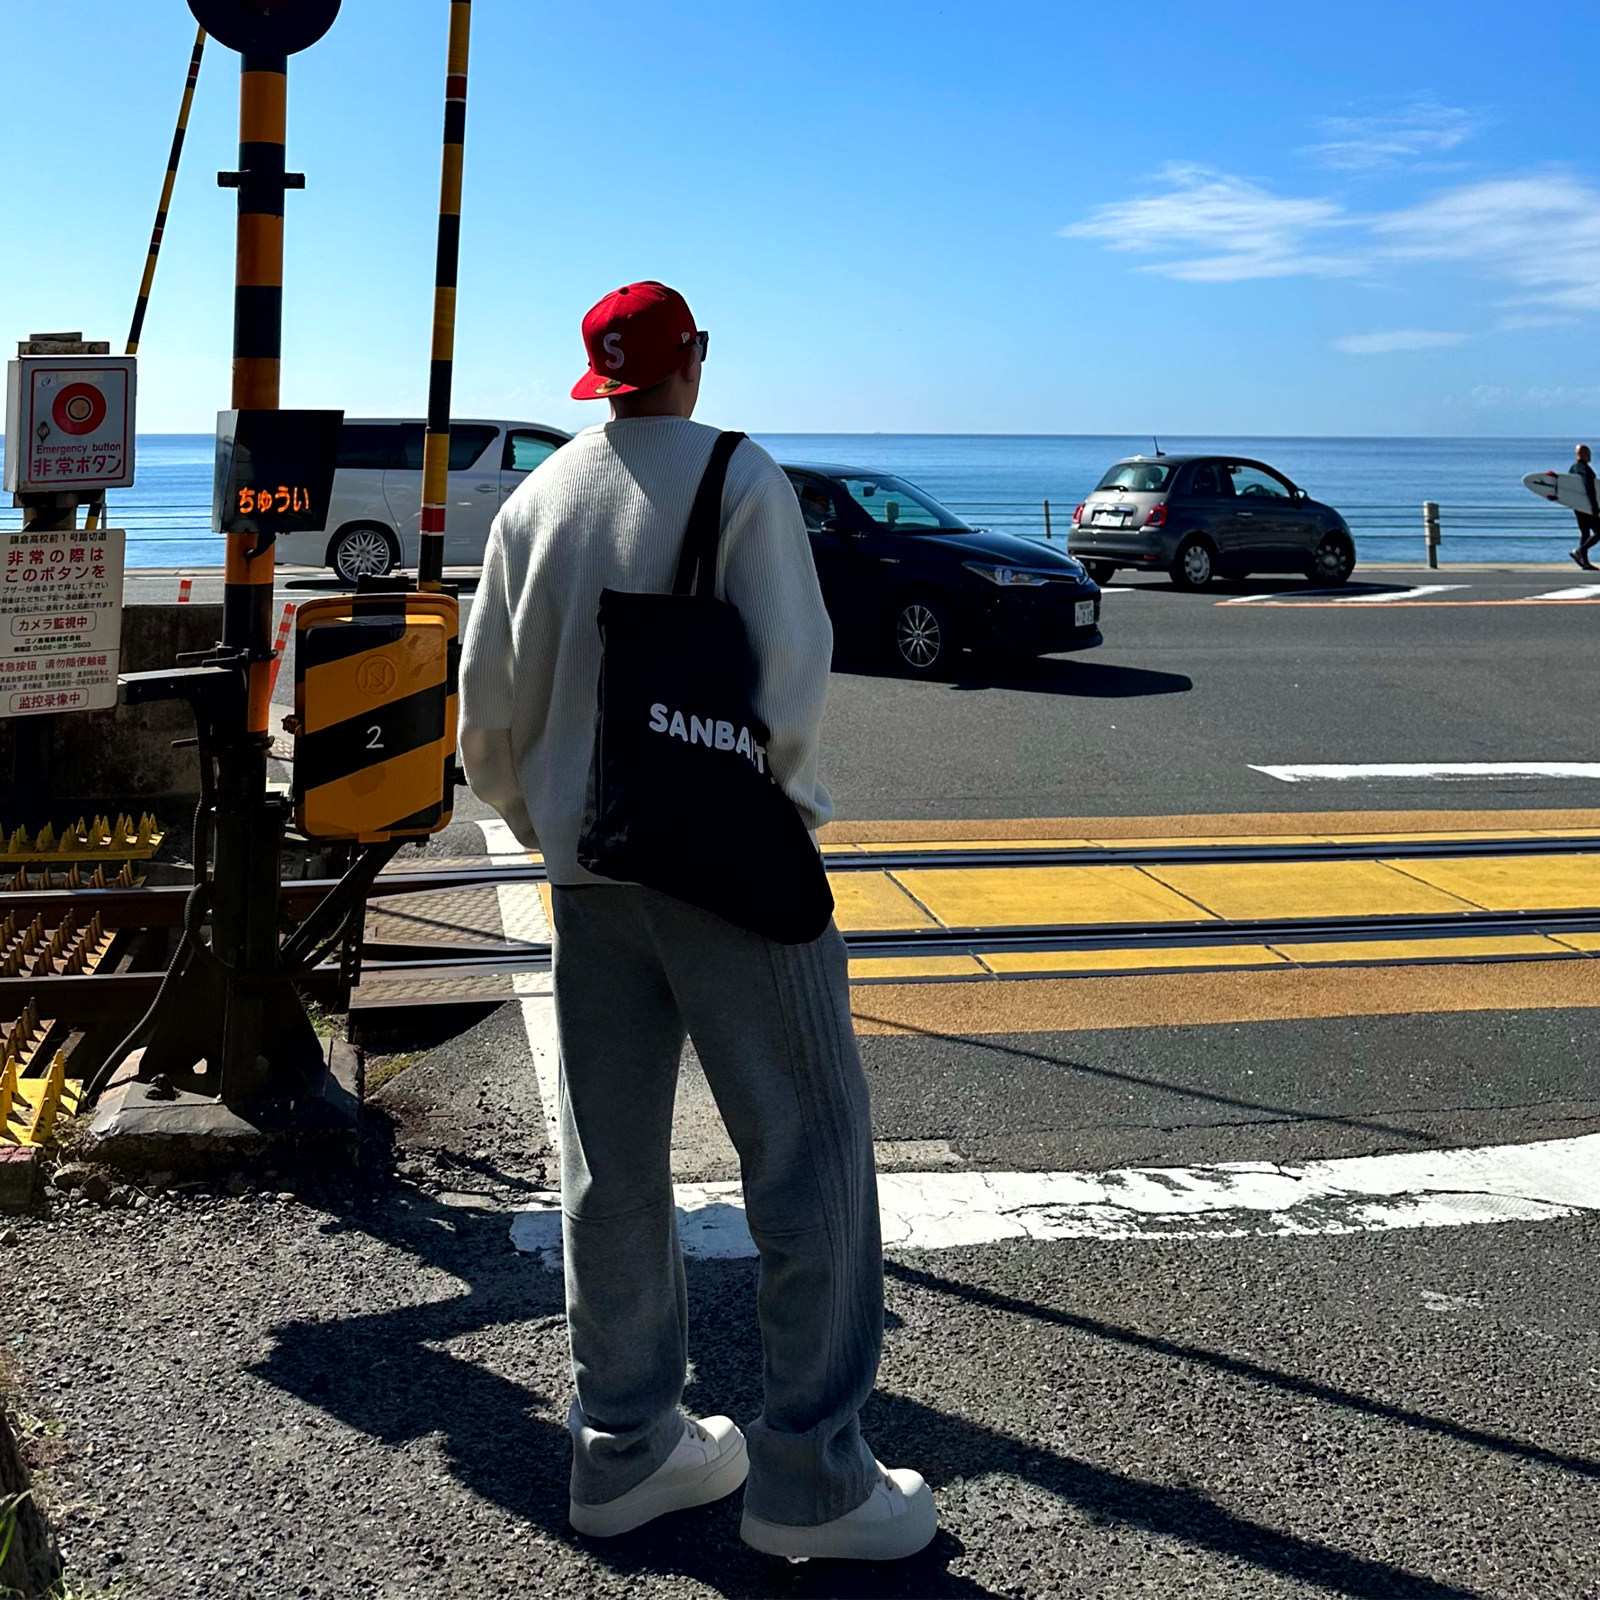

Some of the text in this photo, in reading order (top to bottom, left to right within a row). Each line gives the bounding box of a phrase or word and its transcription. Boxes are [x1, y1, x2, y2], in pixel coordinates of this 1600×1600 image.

[603, 332, 625, 369] S
[37, 442, 121, 455] Emergency button
[33, 455, 122, 477] 非常ボタン
[239, 486, 309, 513] ちゅうい
[8, 548, 104, 566] 非常の際は
[6, 565, 105, 583] このボタンを
[18, 616, 88, 632] カメラ監視中
[366, 725, 385, 749] 2
